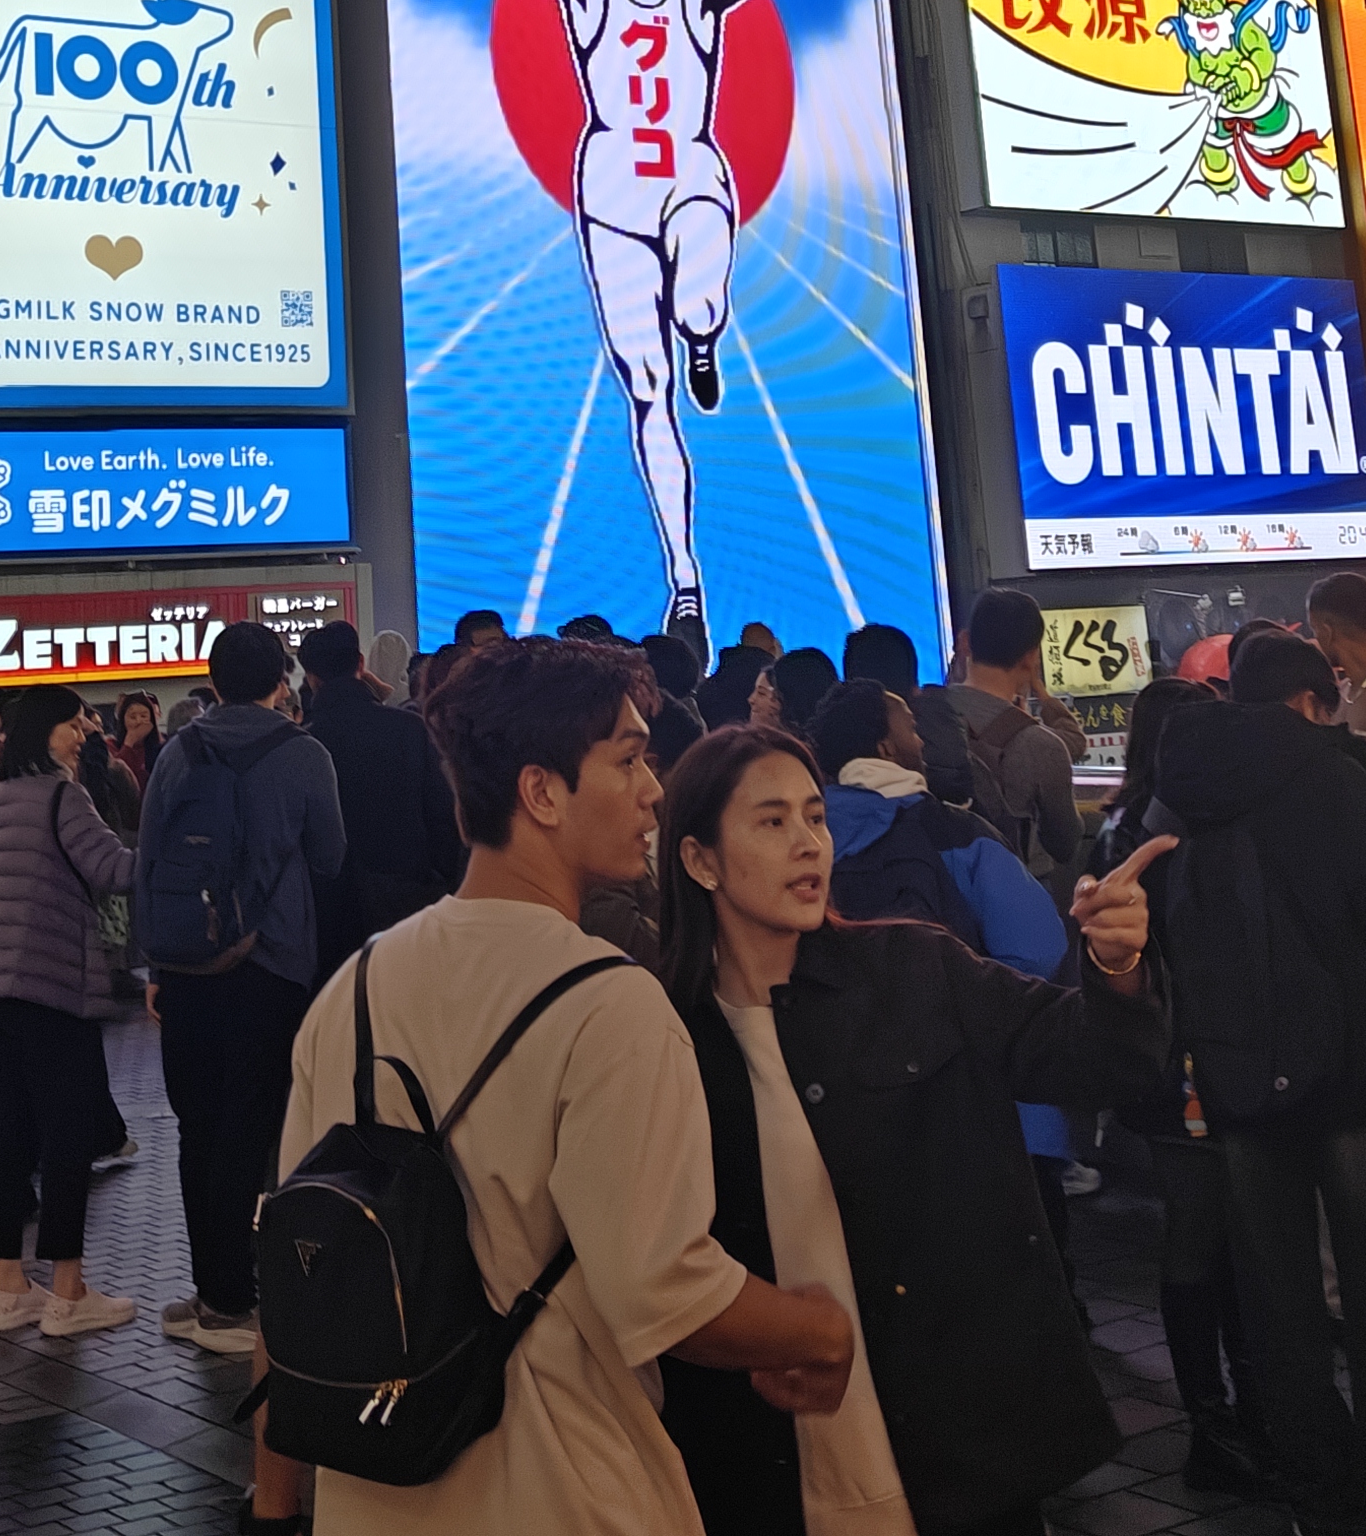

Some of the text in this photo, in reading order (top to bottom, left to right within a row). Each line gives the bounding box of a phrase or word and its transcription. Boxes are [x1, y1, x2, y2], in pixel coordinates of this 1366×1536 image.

[619, 15, 677, 179] グリコ
[89, 300, 165, 324] SNOW
[176, 303, 261, 325] BRAND
[45, 445, 275, 473] Love Earth. Love Life.
[28, 479, 291, 535] 雪印メグミルク
[1040, 533, 1095, 557] 天気予報
[150, 605, 209, 622] ゼッテリア
[1063, 619, 1129, 682] くくる
